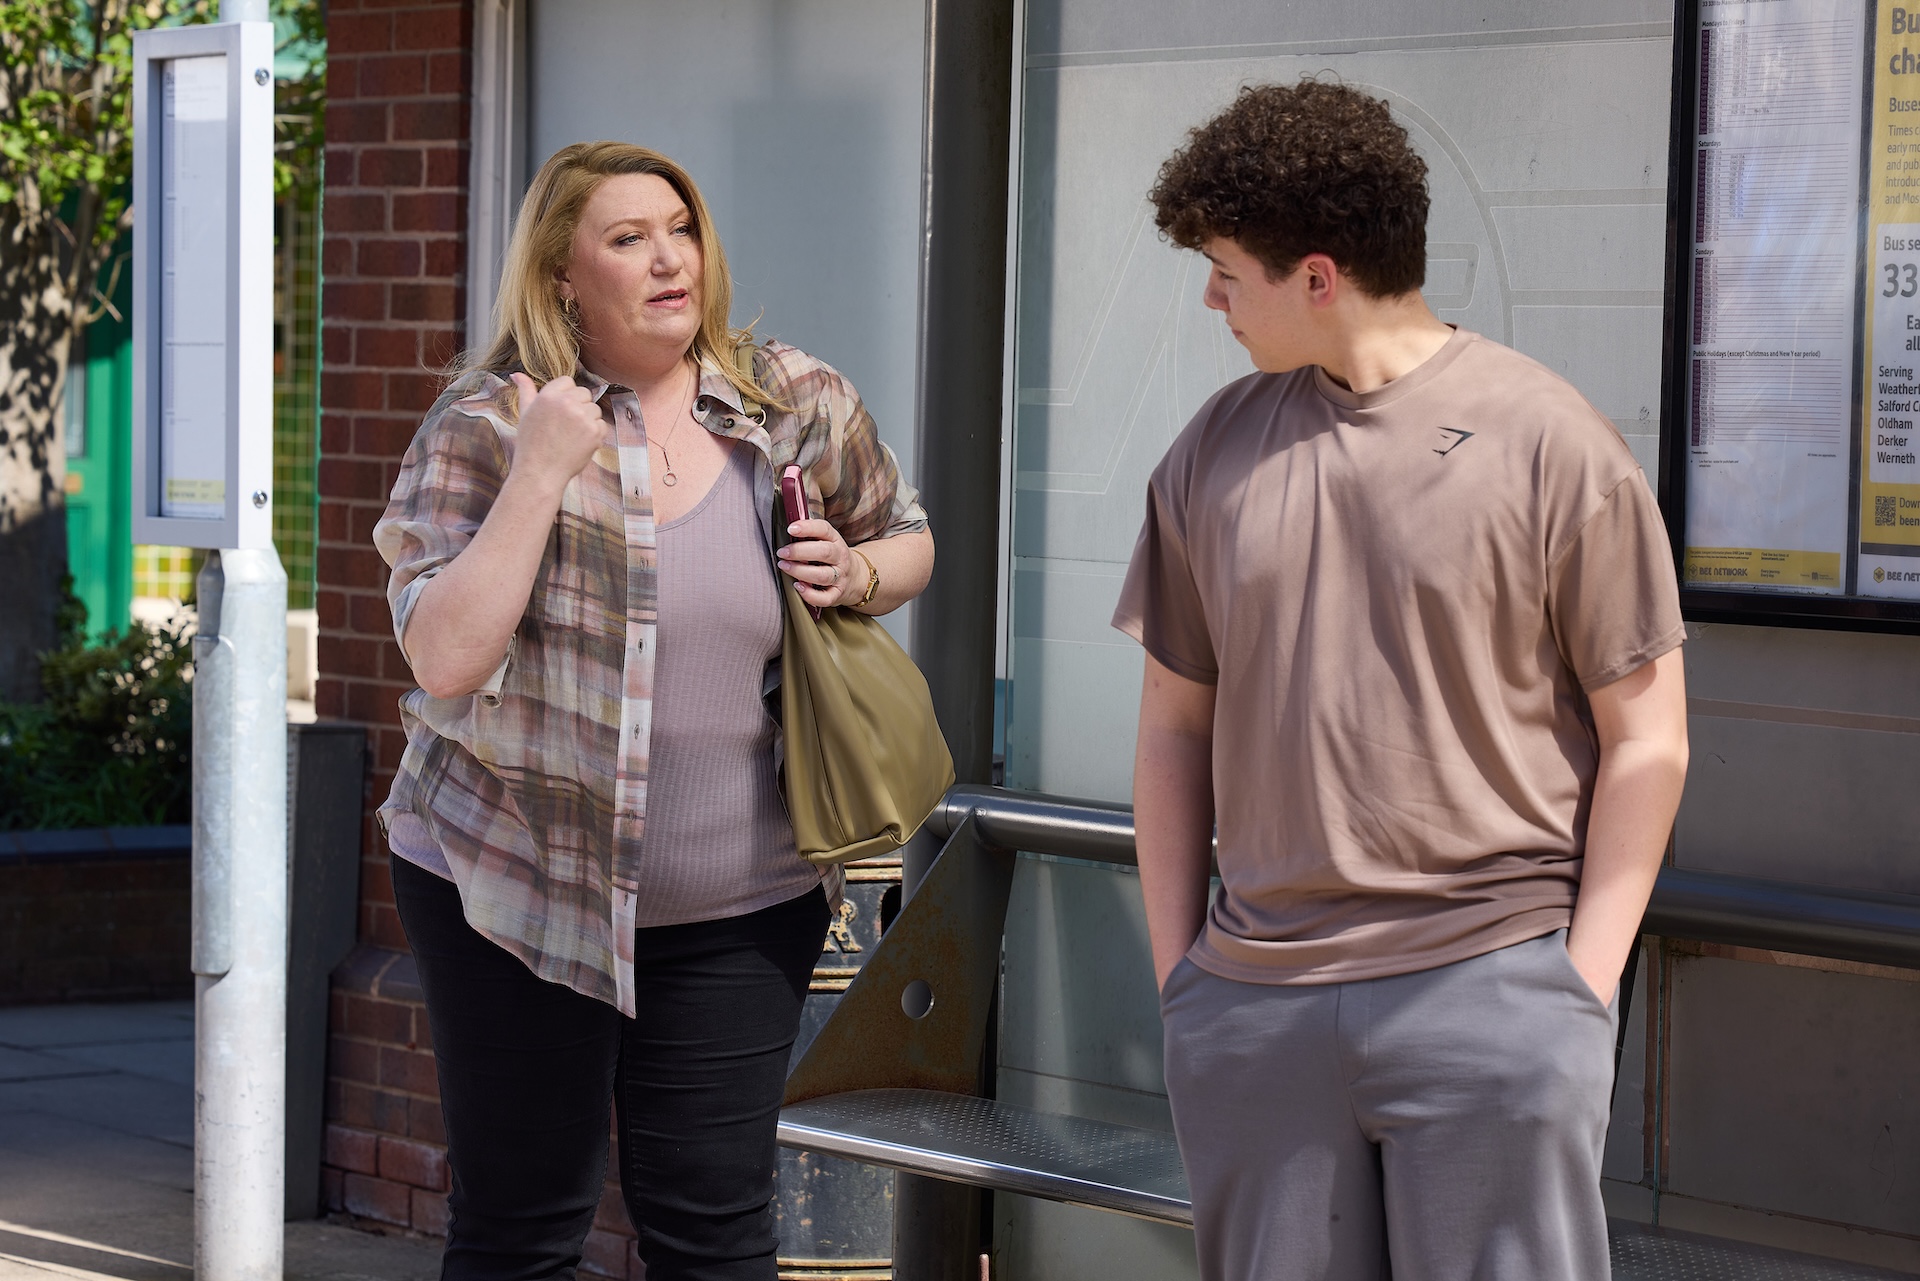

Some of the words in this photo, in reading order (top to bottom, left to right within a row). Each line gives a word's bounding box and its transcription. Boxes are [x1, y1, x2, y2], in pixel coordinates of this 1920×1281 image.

[1888, 124, 1913, 137] Times
[1887, 142, 1908, 156] early
[1886, 159, 1902, 171] and
[1885, 193, 1901, 205] and
[1884, 236, 1905, 251] Bus
[1695, 248, 1714, 257] Sundays
[1882, 263, 1918, 298] 33
[1707, 350, 1727, 359] Holidays
[1727, 350, 1745, 359] (except
[1878, 365, 1913, 381] Serving
[1878, 400, 1911, 412] Salford
[1878, 417, 1913, 429] Oldham
[1877, 435, 1908, 447] Derker
[1877, 452, 1916, 464] Werneth
[1699, 567, 1712, 576] BEE
[1887, 571, 1902, 581] BEE
